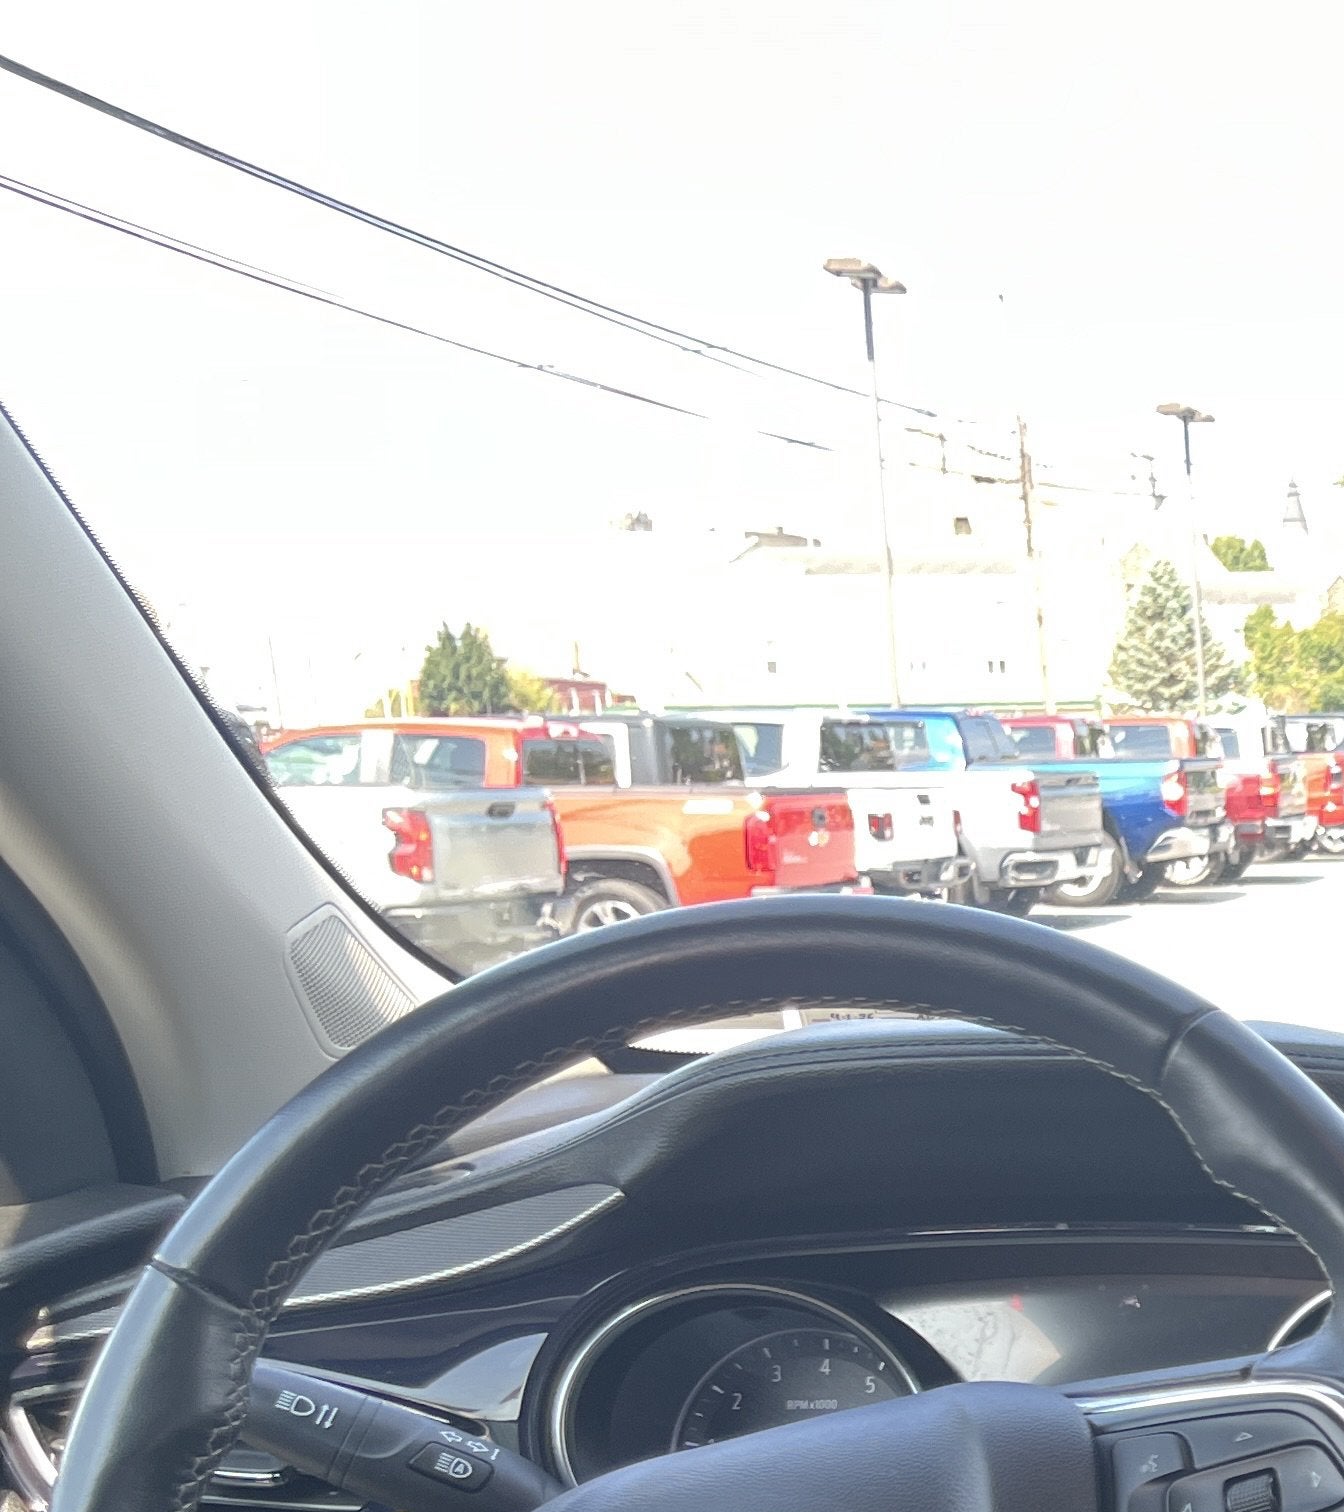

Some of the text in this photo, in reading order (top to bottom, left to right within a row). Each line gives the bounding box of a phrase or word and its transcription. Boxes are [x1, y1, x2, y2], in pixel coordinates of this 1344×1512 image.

[771, 1365, 782, 1383] 3
[818, 1358, 831, 1376] 4
[864, 1376, 876, 1394] 5
[732, 1393, 743, 1410] 2
